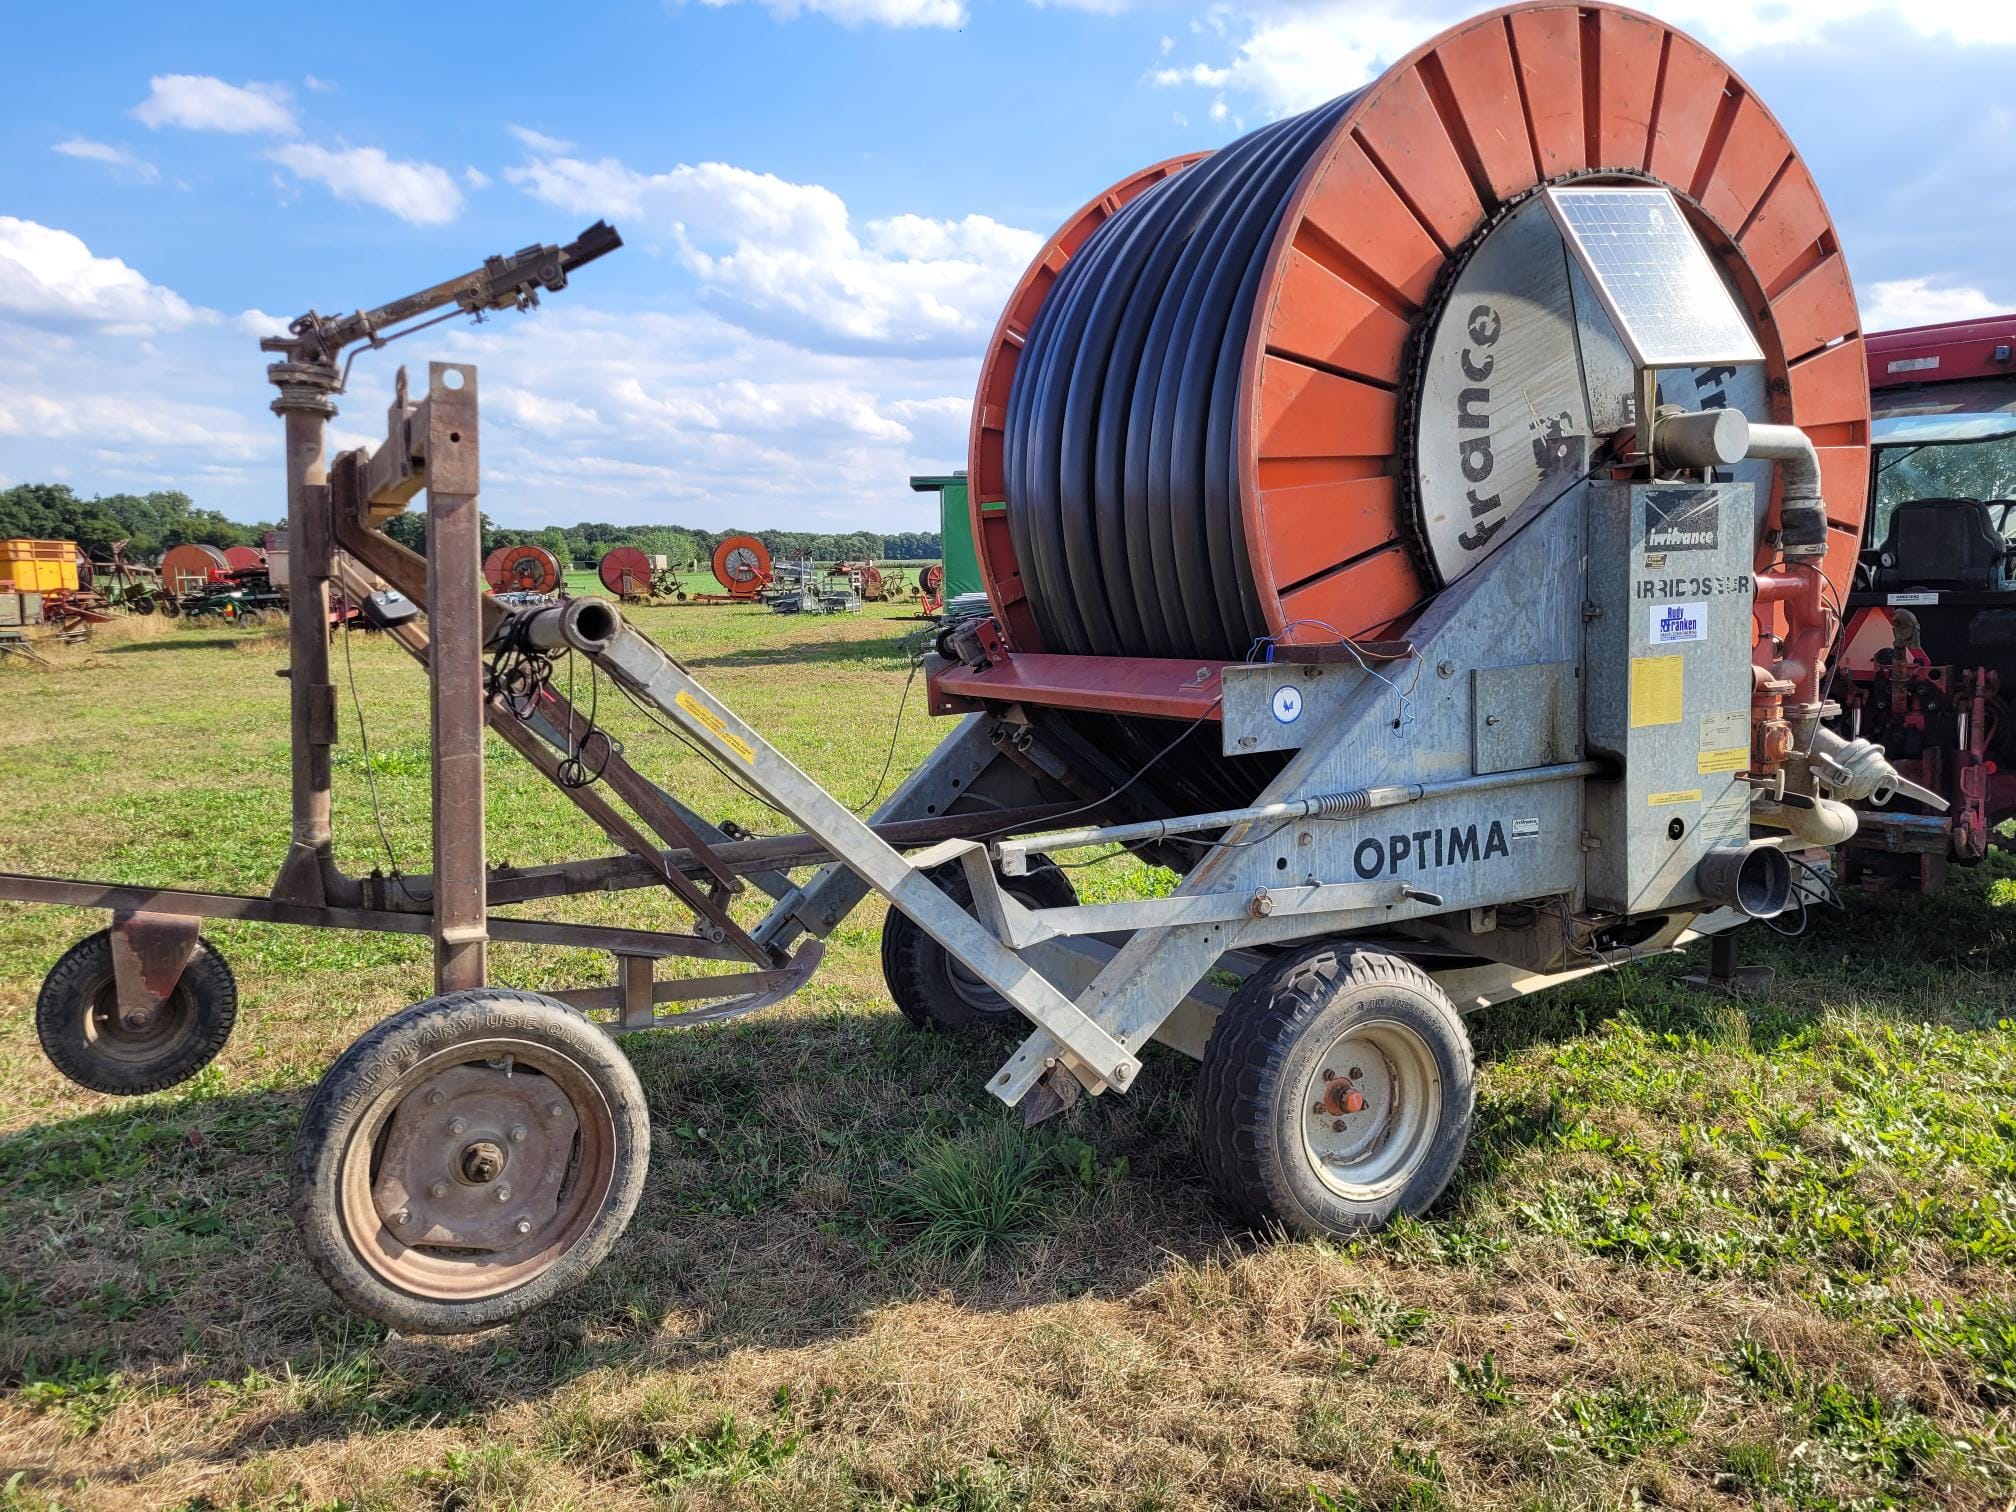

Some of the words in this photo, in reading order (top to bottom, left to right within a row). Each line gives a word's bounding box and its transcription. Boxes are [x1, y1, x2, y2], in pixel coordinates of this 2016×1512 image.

[1661, 618, 1697, 632] Franken
[1667, 606, 1684, 619] Rudy
[1353, 820, 1510, 879] OPTIMA
[332, 1015, 475, 1128] TEMPORARY
[485, 1013, 538, 1031] USE
[546, 1021, 603, 1055] ONLY
